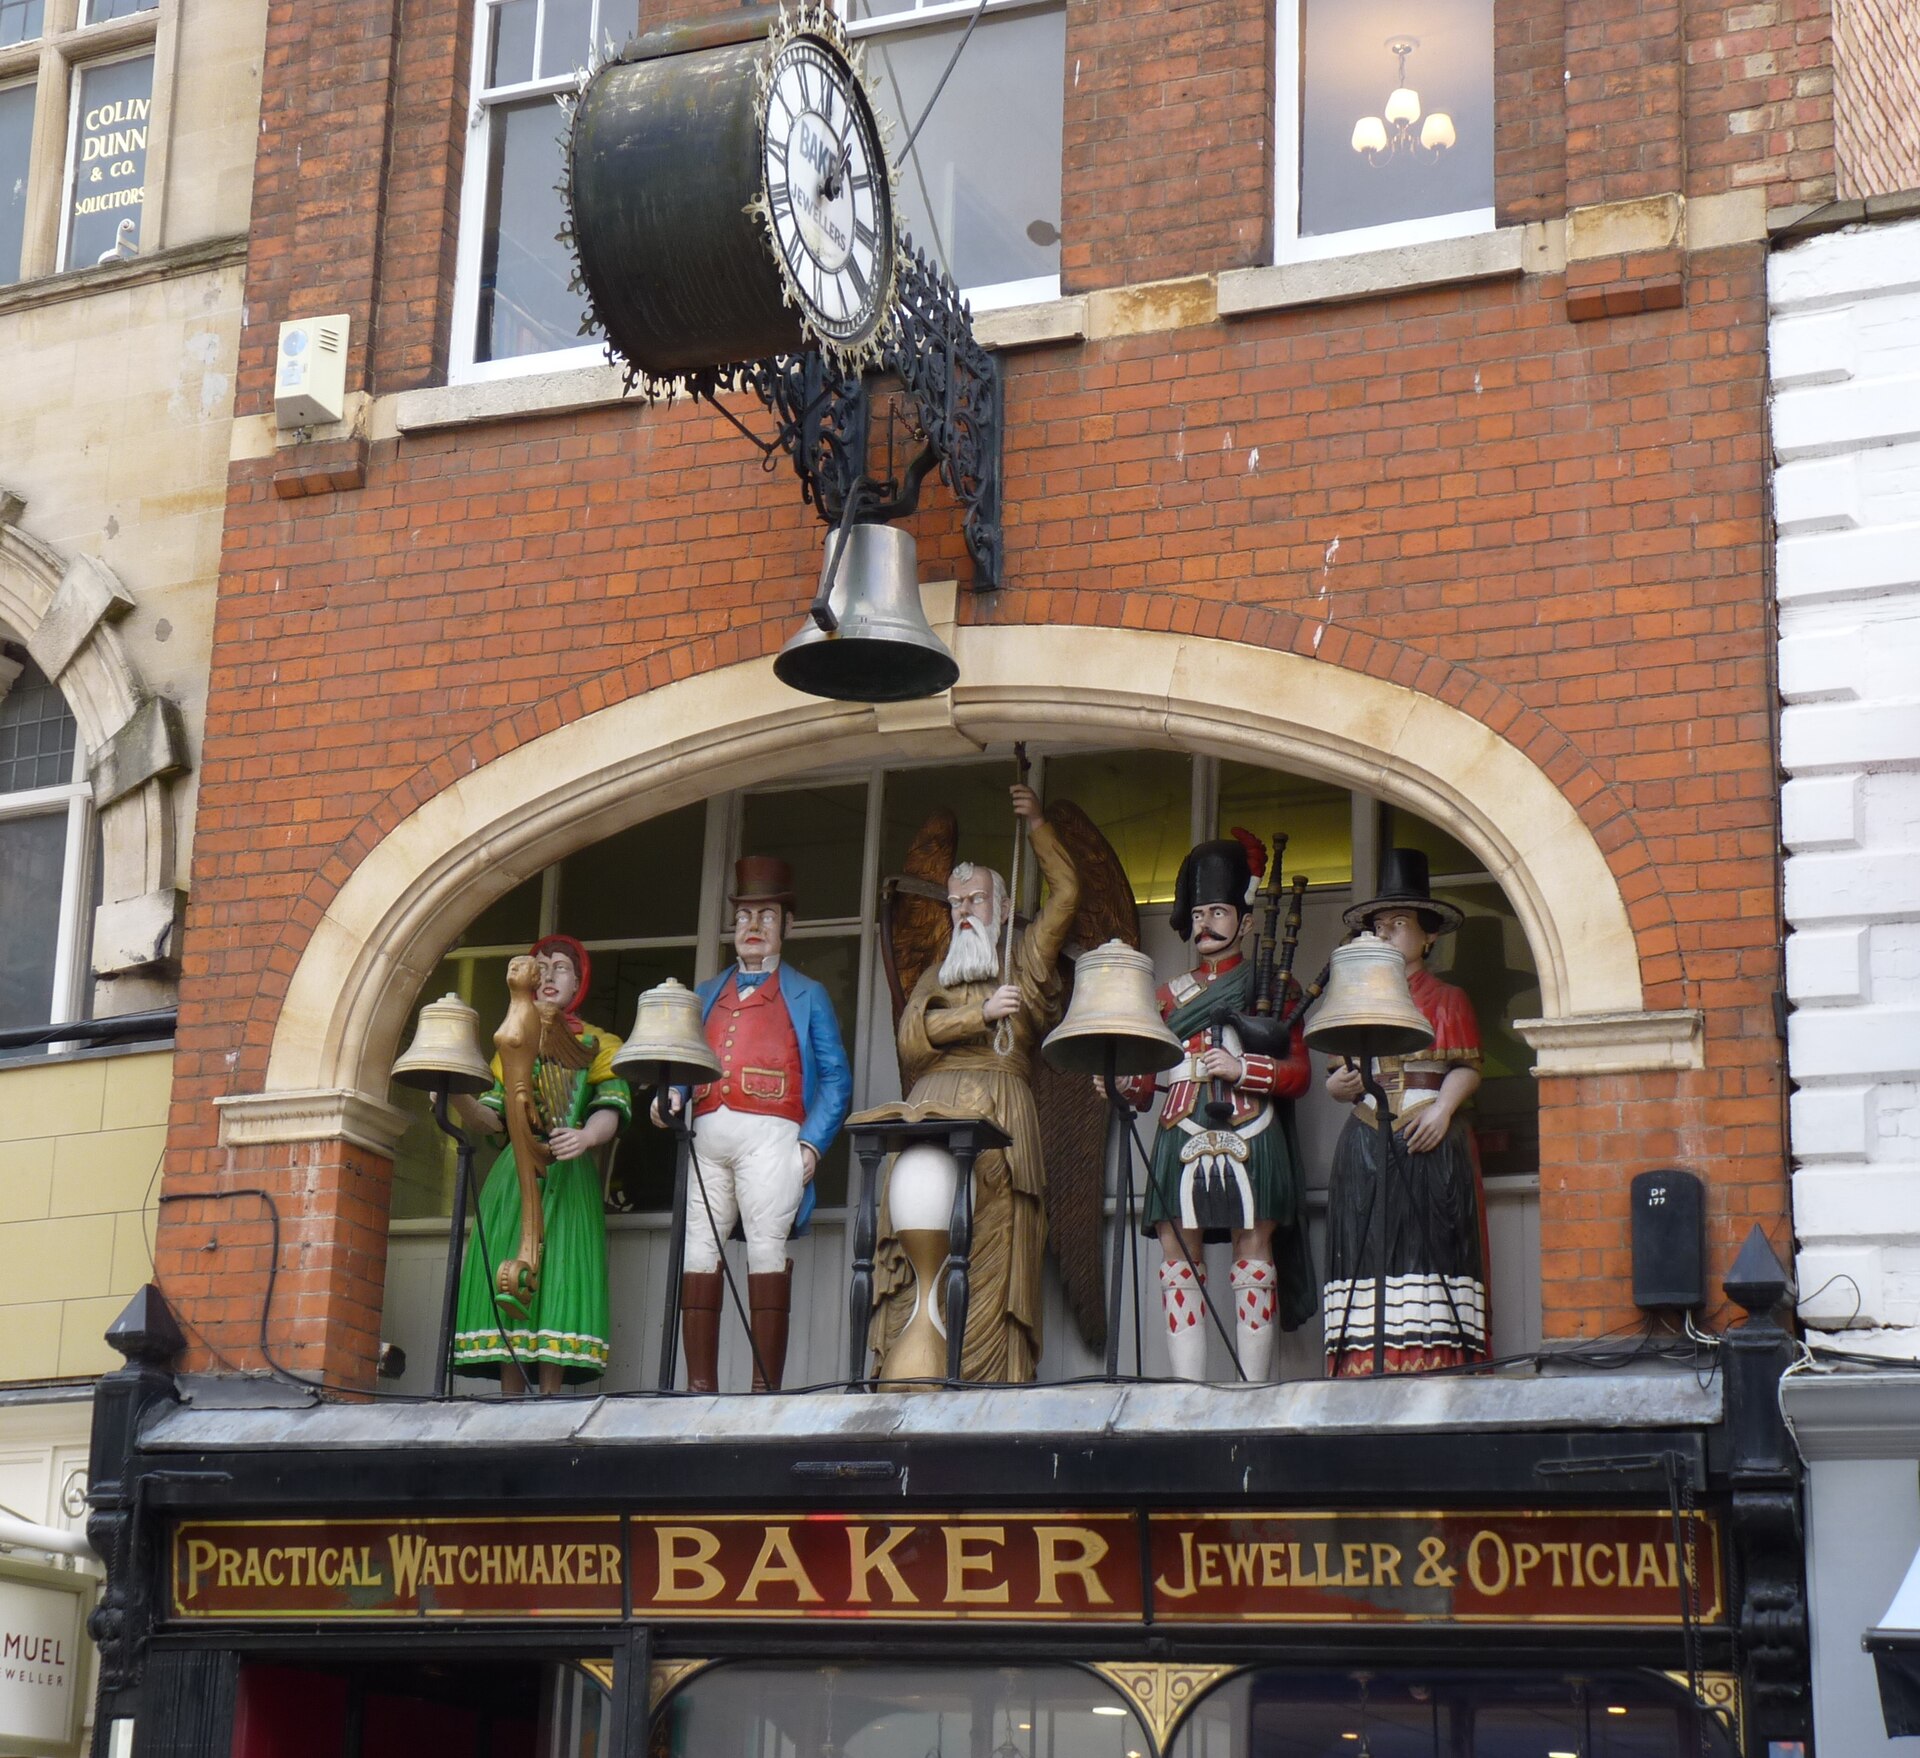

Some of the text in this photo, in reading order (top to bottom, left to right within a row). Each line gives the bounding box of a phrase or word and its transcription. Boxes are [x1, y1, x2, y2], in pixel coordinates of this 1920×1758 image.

[86, 99, 151, 131] COLIN
[82, 126, 147, 161] DUNN
[800, 118, 844, 200] BAKE
[90, 160, 135, 182] & CO.
[75, 186, 145, 216] SOLICITORS
[791, 183, 846, 252] JEWELLERS
[1649, 1197, 1665, 1206] 177
[1651, 1188, 1666, 1197] DP
[187, 1533, 622, 1600] PRACTICAL WATCHMAKER
[651, 1526, 1115, 1604] BAKER
[1154, 1530, 1697, 1598] JEWELLER & OPTICIAN
[0, 1632, 65, 1666] MUEL
[0, 1667, 64, 1687] WELLER
